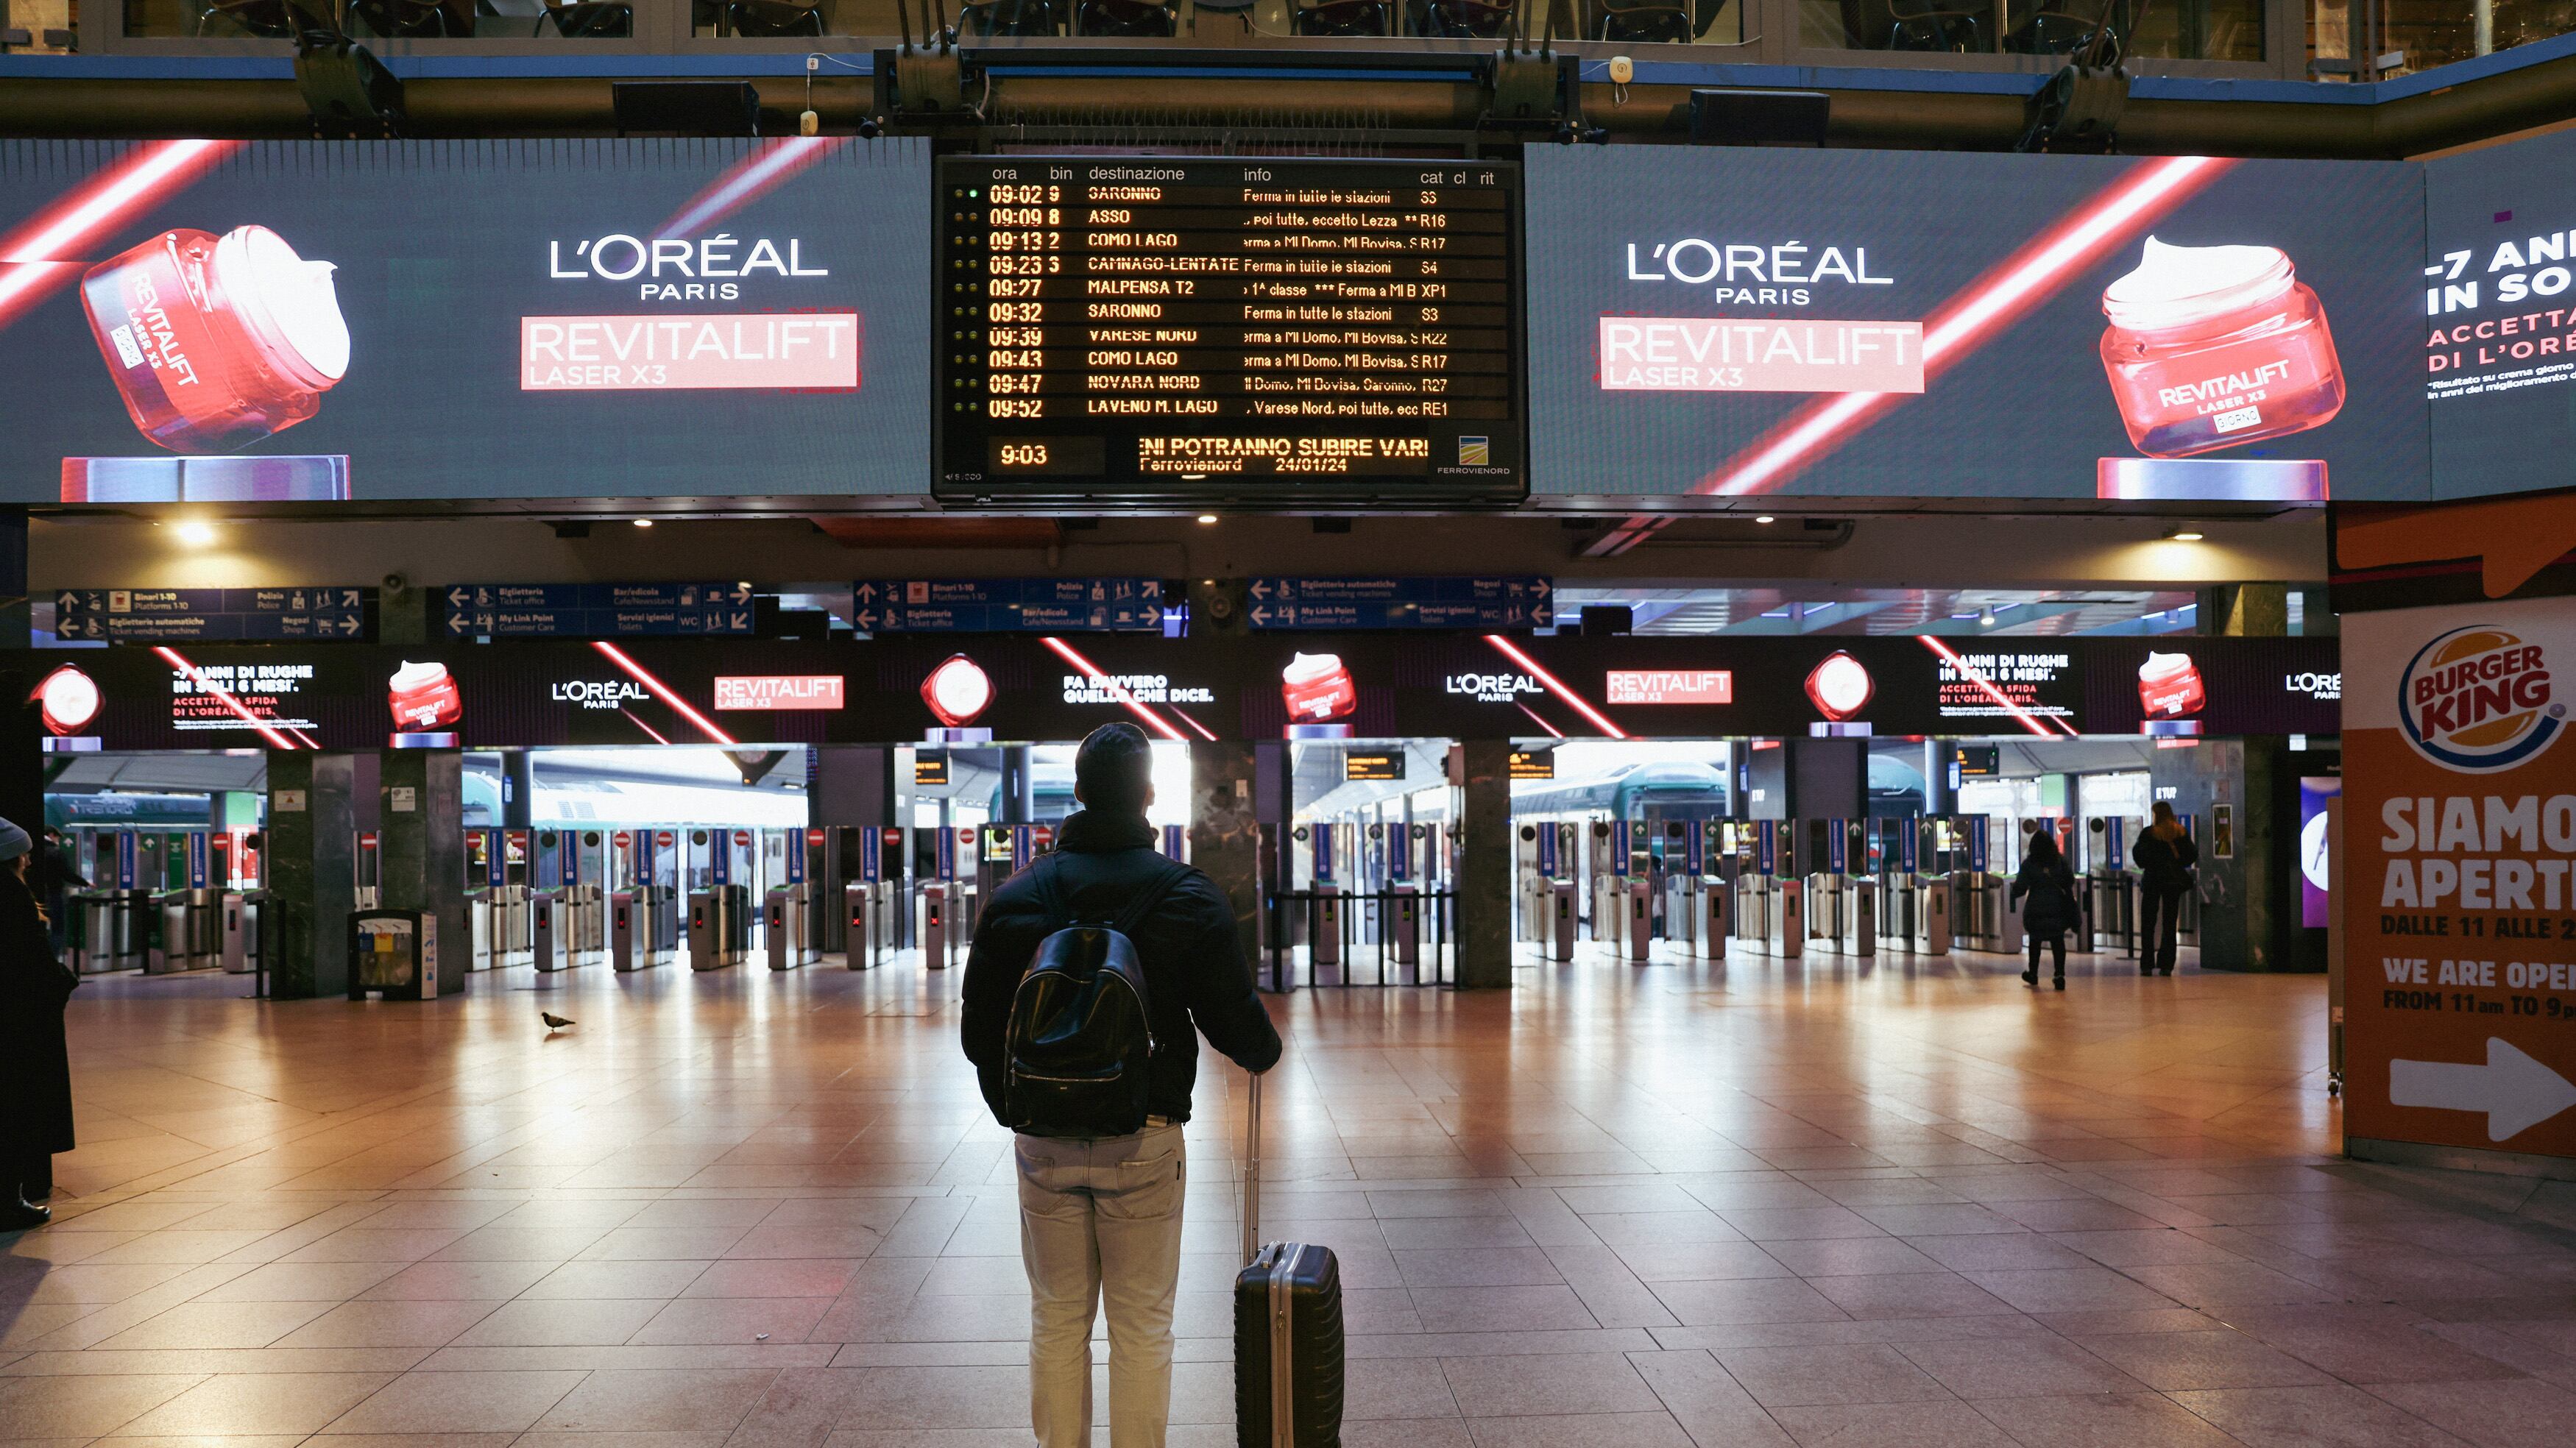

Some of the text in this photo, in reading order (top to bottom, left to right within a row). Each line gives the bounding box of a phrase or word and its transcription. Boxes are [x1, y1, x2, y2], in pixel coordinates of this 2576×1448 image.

[992, 167, 1495, 185] ora bin destinazione info cat cl rit
[989, 185, 1042, 204] 09:02
[1049, 185, 1060, 202] 9
[989, 208, 1042, 227] 09:09
[1049, 208, 1060, 225] 8
[1089, 210, 1130, 224] ASSO
[1253, 215, 1273, 227] poi
[1312, 214, 1358, 226] eccetto
[1362, 214, 1397, 227] Lezza
[1420, 214, 1446, 227] R16
[989, 232, 1446, 251] 09:13 2 COMO LAGO R17
[550, 233, 829, 280] L'ORÉAL
[1627, 238, 1894, 285] L'ORÉAL
[2424, 228, 2576, 280] -7 AN
[989, 255, 1042, 274] 09:23
[1049, 256, 1060, 273] 3
[1089, 257, 1239, 271] CAMNAGO-LENTATE
[989, 279, 1446, 297] 09:27 MALPENSA T2 XP1
[2427, 280, 2478, 316] IN
[989, 302, 1438, 322] 09:32 SARONNO Ferma in tutte le stazioni S3
[127, 308, 152, 351] LASER
[131, 272, 199, 387] REVITALIFT
[989, 327, 1042, 347] 09:39
[1089, 330, 1152, 341] VARESE
[1156, 330, 1197, 341] NORD
[528, 320, 849, 362] REVITALIFT
[1607, 324, 1917, 366] REVITALIFT
[989, 350, 1447, 369] 09:43 COMO LAGO R17
[2428, 351, 2461, 372] DI
[528, 364, 667, 386] LASER X3
[989, 374, 1042, 394] 09:47
[1089, 376, 1154, 389] NOVARA
[1159, 376, 1200, 389] NORD
[1609, 365, 1744, 388] LASER X3
[2158, 359, 2290, 408] REVITALIFT
[2497, 368, 2533, 380] crema
[989, 400, 1447, 418] 09:52 LAVENO M. LAGO RE1
[2196, 389, 2267, 415] LASER X3
[2217, 410, 2258, 429] GIORNO
[1001, 444, 1048, 465] 9:03
[1171, 439, 1292, 456] POTRANNO
[1298, 439, 1373, 456] SUBIRE
[1275, 458, 1347, 472] 24/01/24
[1437, 467, 1510, 475] FERROVIENORD
[679, 616, 699, 627] WC
[1480, 608, 1499, 620] WC
[237, 666, 255, 679] DI
[258, 665, 313, 678] RUGHE
[1064, 675, 1087, 689] FA
[2415, 645, 2544, 706] BURGER
[173, 680, 250, 693] IN 6
[552, 681, 650, 701] L'ORÉAL
[717, 678, 841, 700] REVITALIFT
[1446, 673, 1544, 694] L'ORÉAL
[1610, 673, 1729, 692] REVITALIFT
[245, 697, 278, 706] SFIDA
[717, 698, 771, 709] LASER X3
[1133, 688, 1167, 703] CHE
[1170, 688, 1214, 703] DICE.
[1610, 692, 1663, 703] LASER X3
[2421, 670, 2550, 743] KING
[2381, 858, 2576, 910] APERT
[2381, 915, 2449, 937] DALLE
[2458, 917, 2484, 937] 11
[2494, 918, 2551, 939] ALLE
[2382, 957, 2428, 984] WE
[2438, 959, 2496, 987] ARE
[2383, 990, 2442, 1011] FROM
[2510, 995, 2538, 1016] TO
